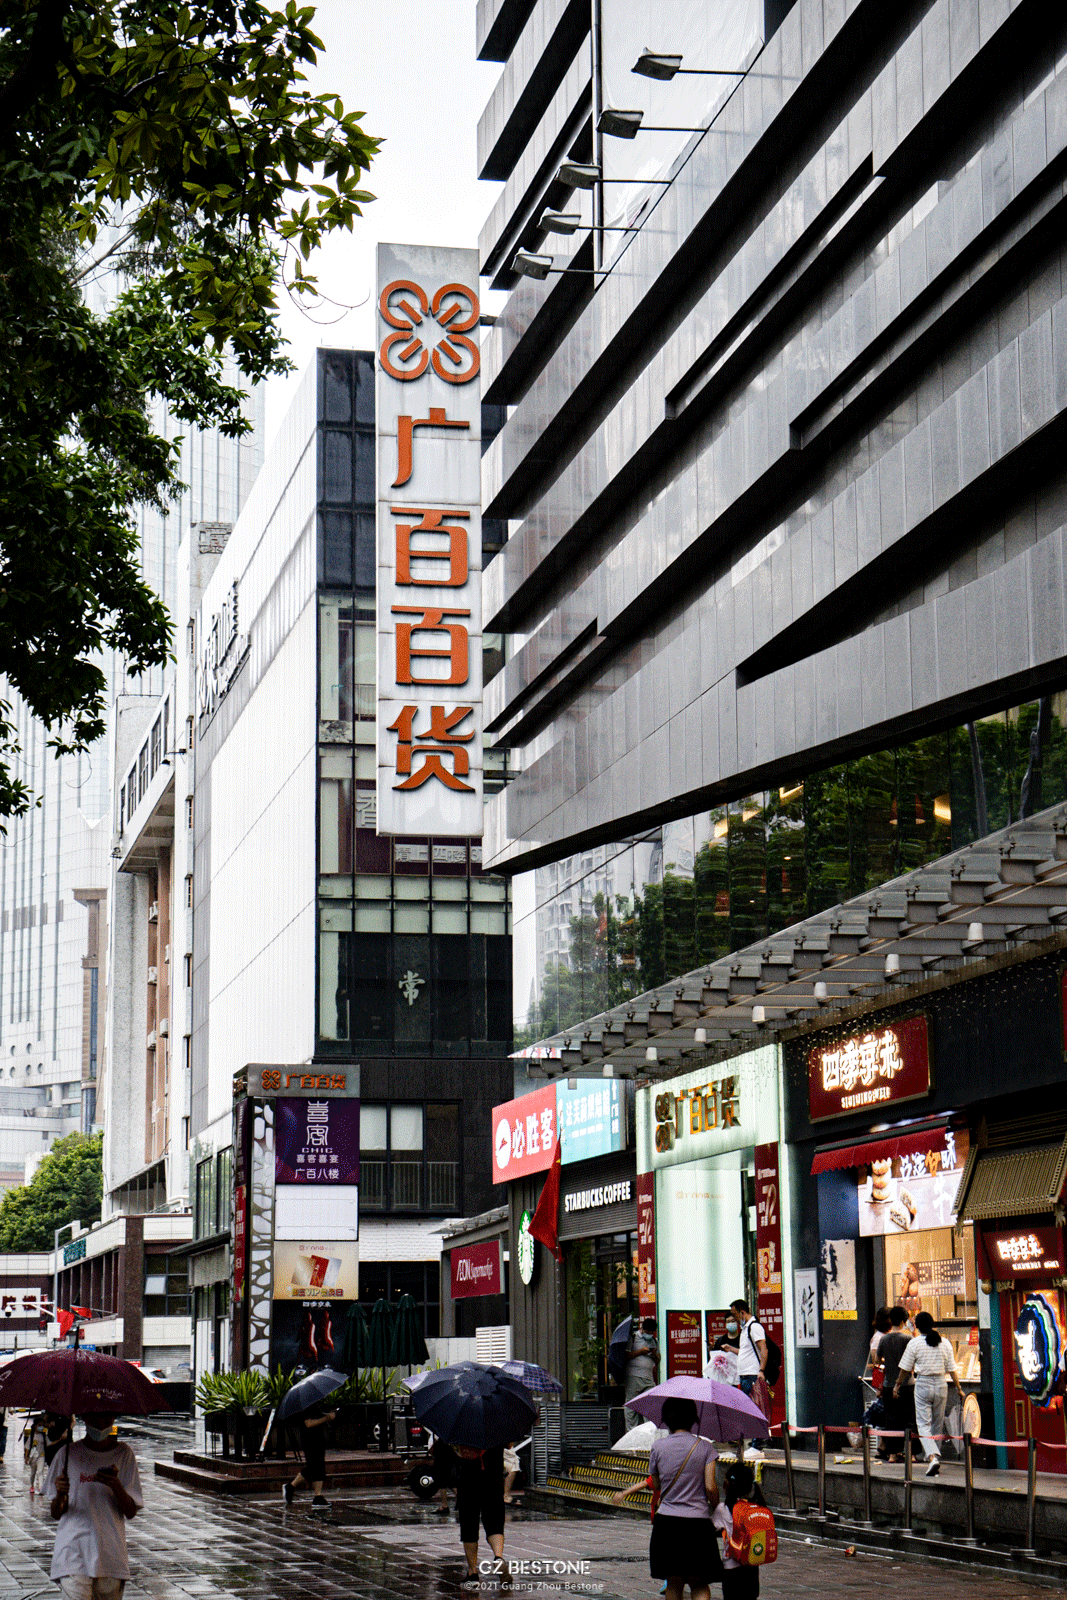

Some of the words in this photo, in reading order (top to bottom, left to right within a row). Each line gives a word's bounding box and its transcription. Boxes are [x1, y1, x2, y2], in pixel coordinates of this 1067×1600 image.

[387, 408, 476, 792] 广百百货
[399, 970, 426, 1006] 常
[285, 1073, 346, 1090] 广百百货
[511, 1107, 555, 1160] 必胜客
[294, 1168, 340, 1180] 广百八楼
[564, 1186, 604, 1213] STARBUCKS
[603, 1180, 631, 1205] COFFEE
